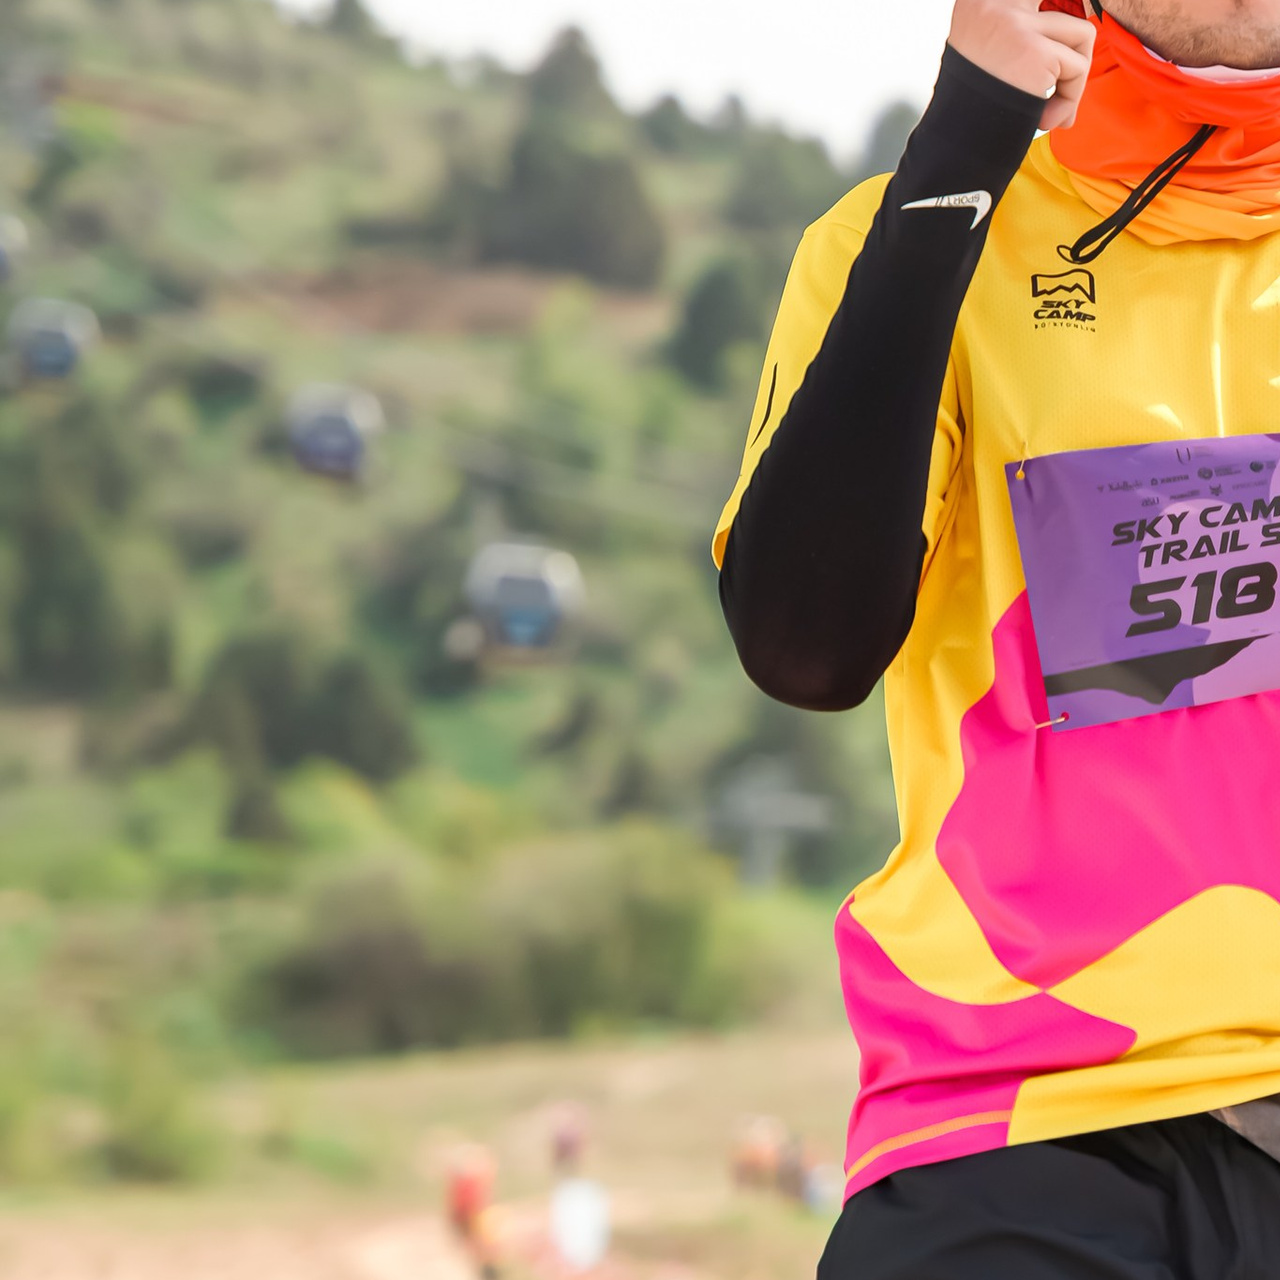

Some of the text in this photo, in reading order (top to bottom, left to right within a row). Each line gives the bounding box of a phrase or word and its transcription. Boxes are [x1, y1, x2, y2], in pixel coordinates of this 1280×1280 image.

[1033, 309, 1096, 323] CAMP
[1041, 299, 1087, 309] SKY
[1111, 511, 1190, 546] SKY
[1139, 528, 1252, 569] TRAIL
